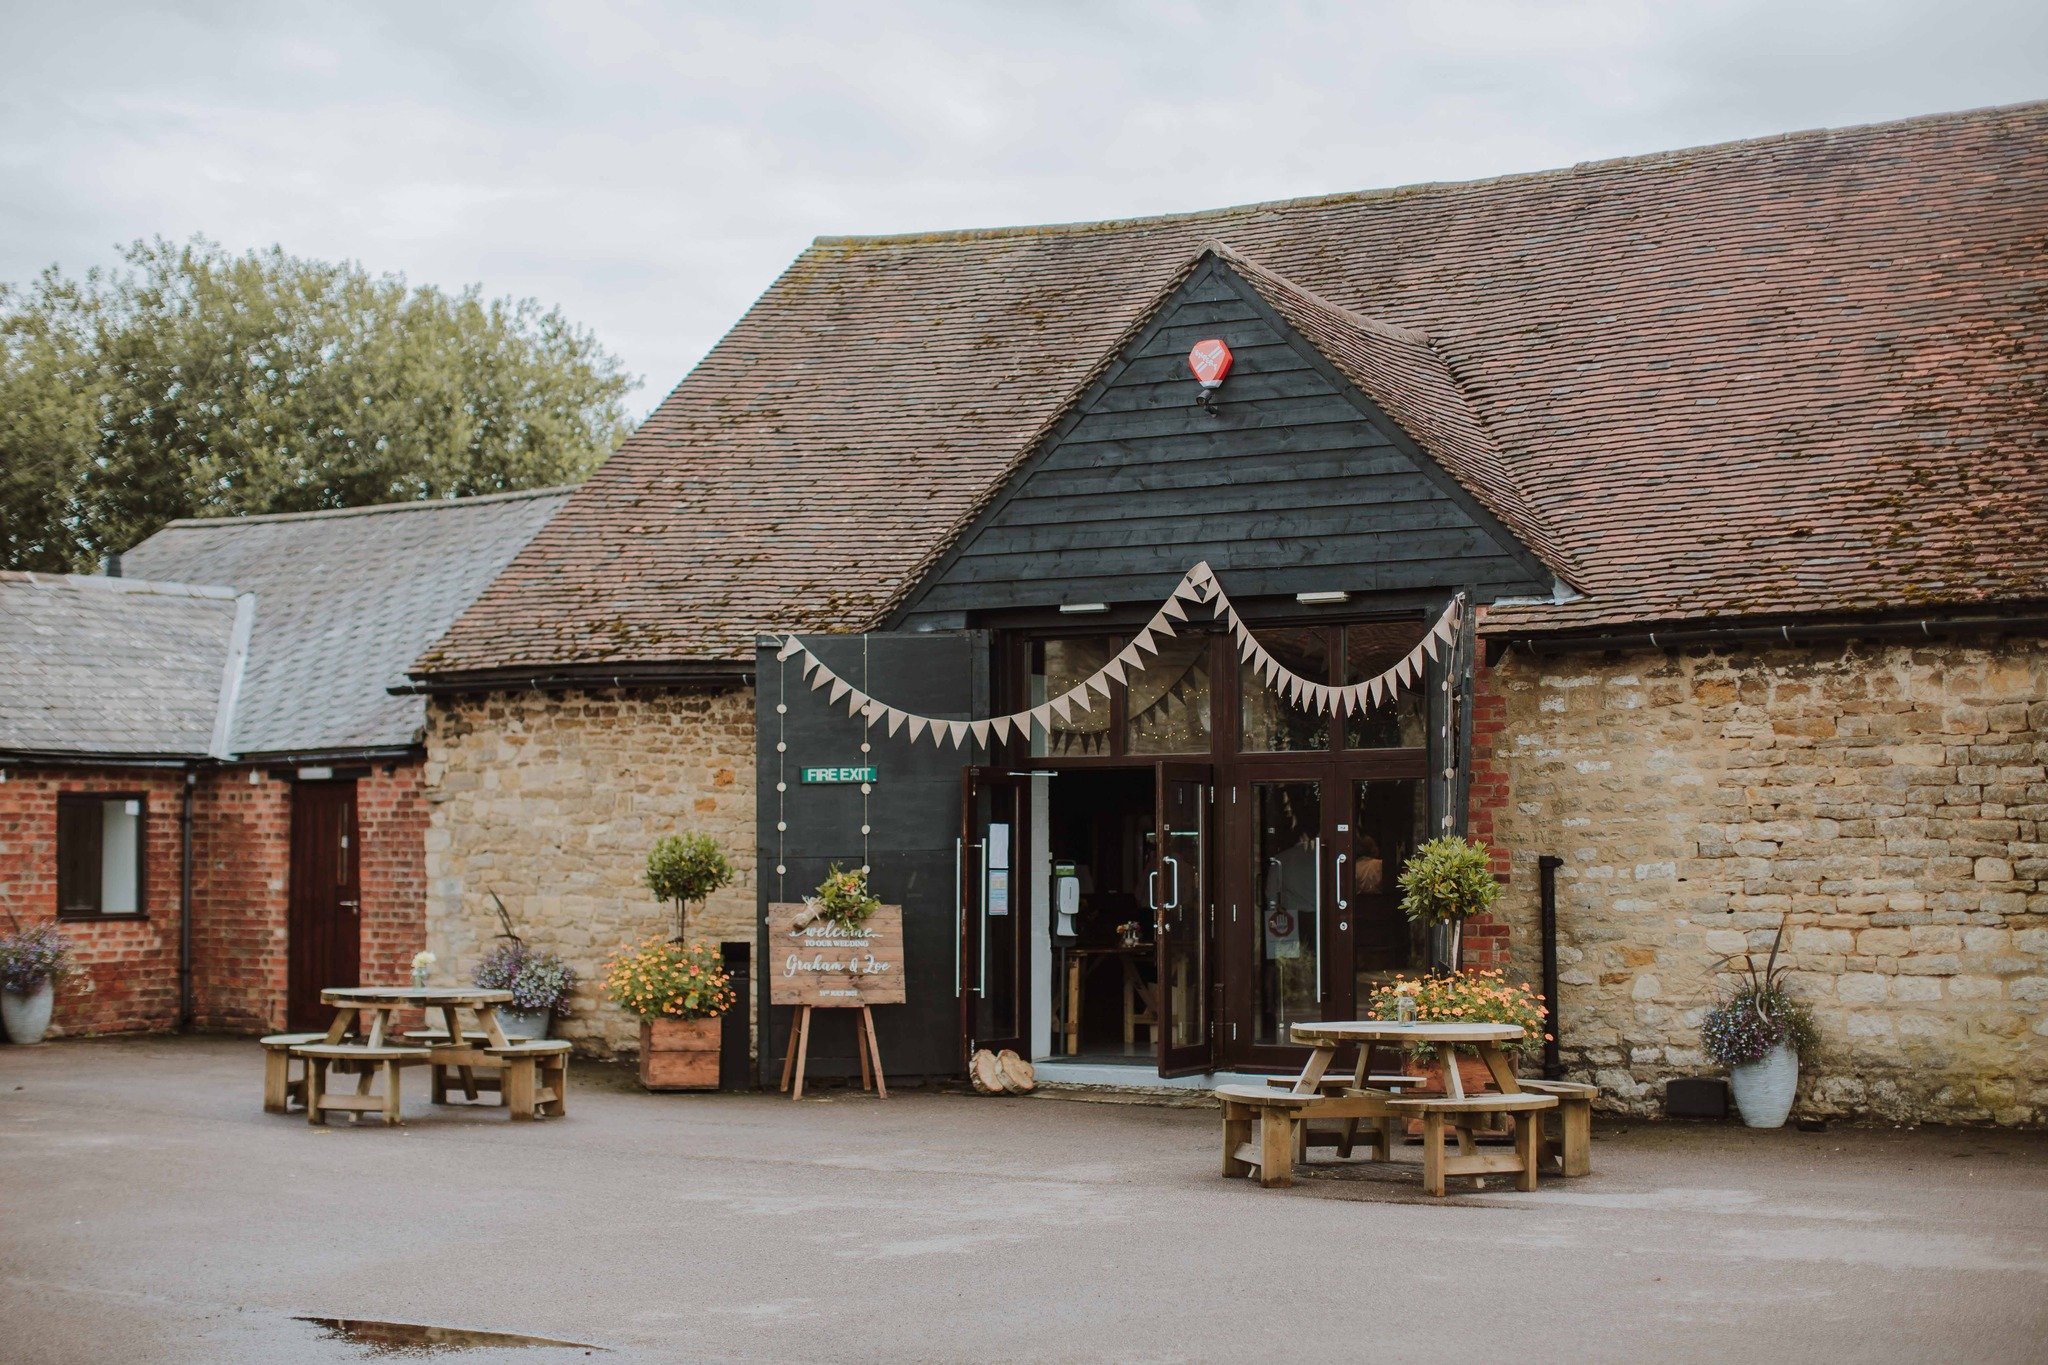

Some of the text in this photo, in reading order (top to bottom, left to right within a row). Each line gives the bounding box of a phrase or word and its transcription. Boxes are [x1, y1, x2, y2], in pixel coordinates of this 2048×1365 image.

[807, 767, 871, 781] FIRE EXIT
[833, 939, 869, 947] WEDDING
[783, 953, 891, 977] Graham & Zoe
